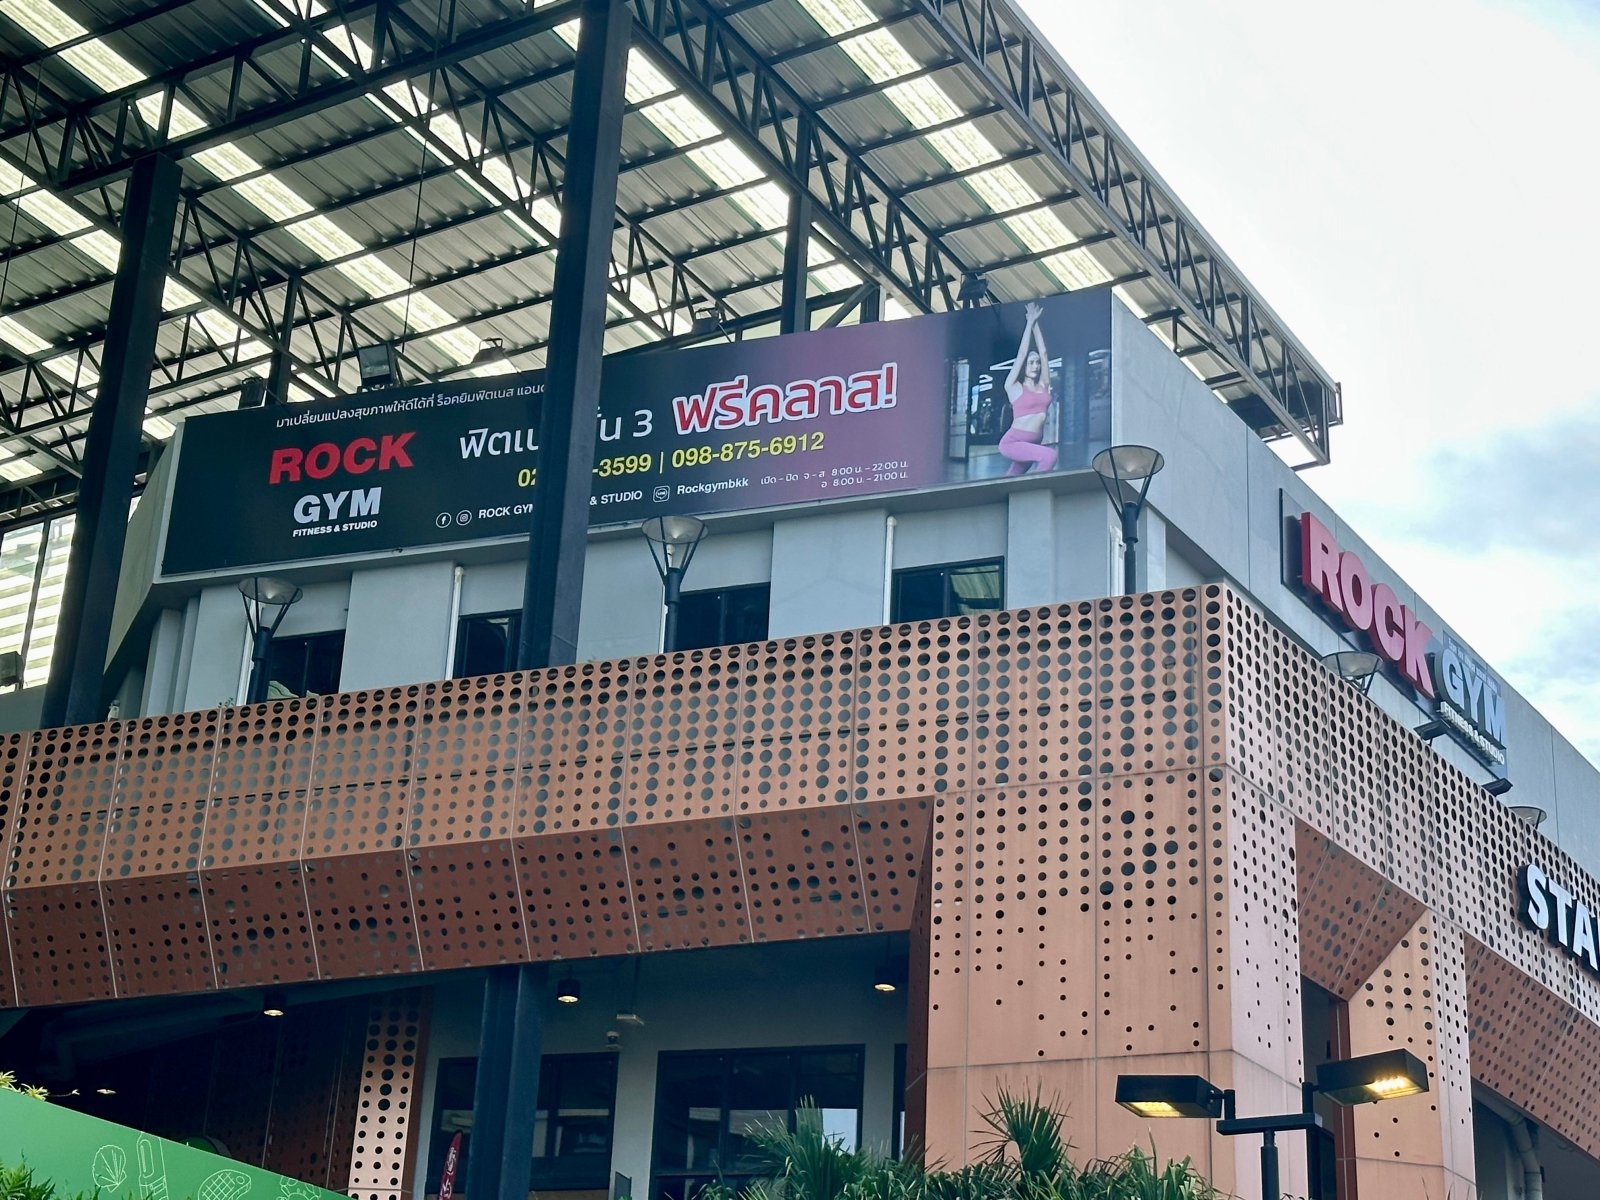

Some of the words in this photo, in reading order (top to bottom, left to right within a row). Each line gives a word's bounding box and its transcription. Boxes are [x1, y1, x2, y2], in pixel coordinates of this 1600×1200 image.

[632, 409, 653, 438] 3
[672, 361, 898, 436] ฟรีคลาส!
[269, 431, 416, 486] ROCK
[671, 431, 825, 468] 098-875-6912
[293, 486, 382, 524] GYM
[478, 505, 511, 519] ROCK
[600, 489, 643, 504] STUDIO
[677, 477, 749, 496] Rockgymbkk
[292, 524, 332, 538] FITNESS
[333, 523, 341, 532] &
[342, 519, 378, 532] STUDIO
[1301, 512, 1435, 699] ROCK
[1437, 648, 1506, 748] GYM
[1479, 734, 1505, 766] STUDIO
[1520, 864, 1600, 973] STA
